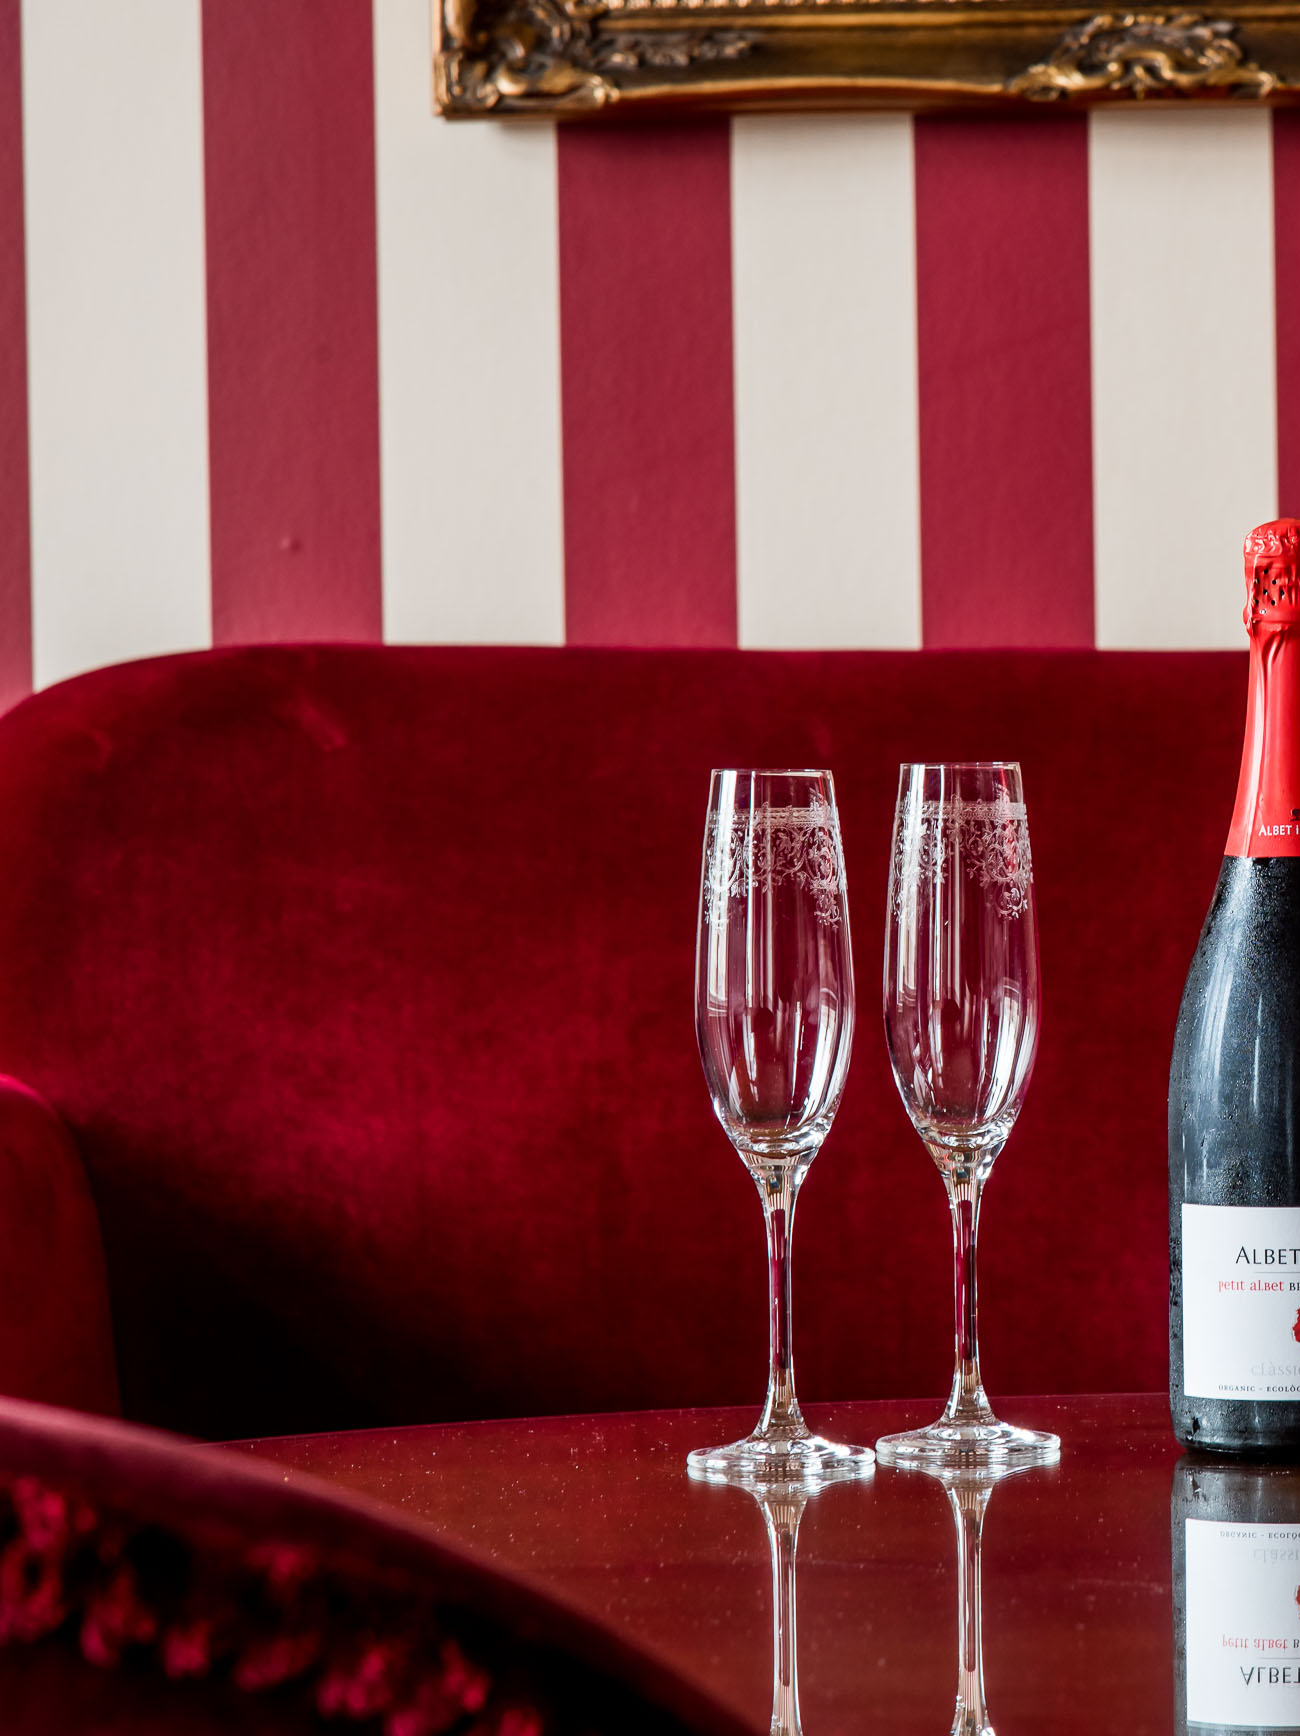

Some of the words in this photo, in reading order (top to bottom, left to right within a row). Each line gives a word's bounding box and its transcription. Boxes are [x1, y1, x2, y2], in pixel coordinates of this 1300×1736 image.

[1259, 824, 1292, 836] ALBET
[1236, 1246, 1300, 1265] ALBET
[1218, 1280, 1245, 1292] petit
[1219, 1384, 1255, 1392] ORGANIC
